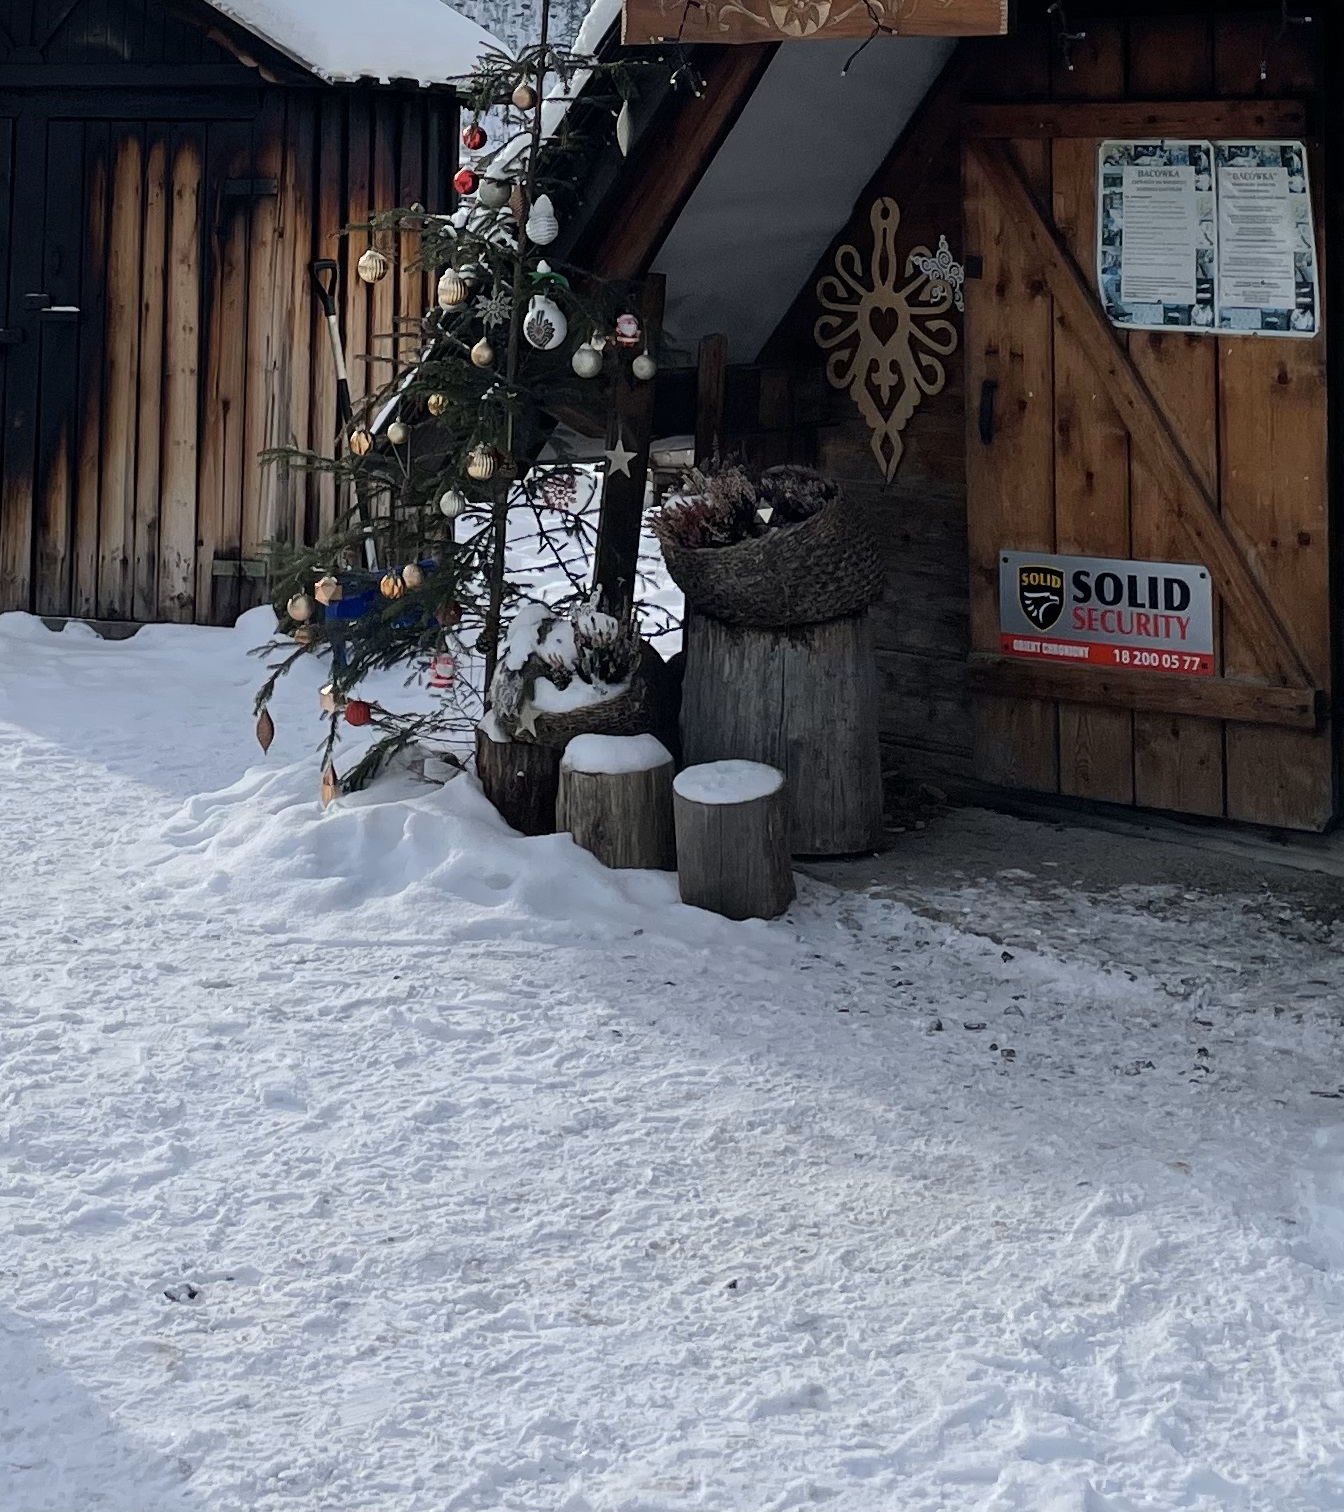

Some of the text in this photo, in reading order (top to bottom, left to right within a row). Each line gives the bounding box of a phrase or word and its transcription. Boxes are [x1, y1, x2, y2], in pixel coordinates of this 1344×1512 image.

[1021, 572, 1062, 589] SOLID
[1072, 570, 1191, 612] SOLID
[1072, 606, 1191, 640] SECURITY
[1113, 649, 1201, 671] 18 200 05 77
